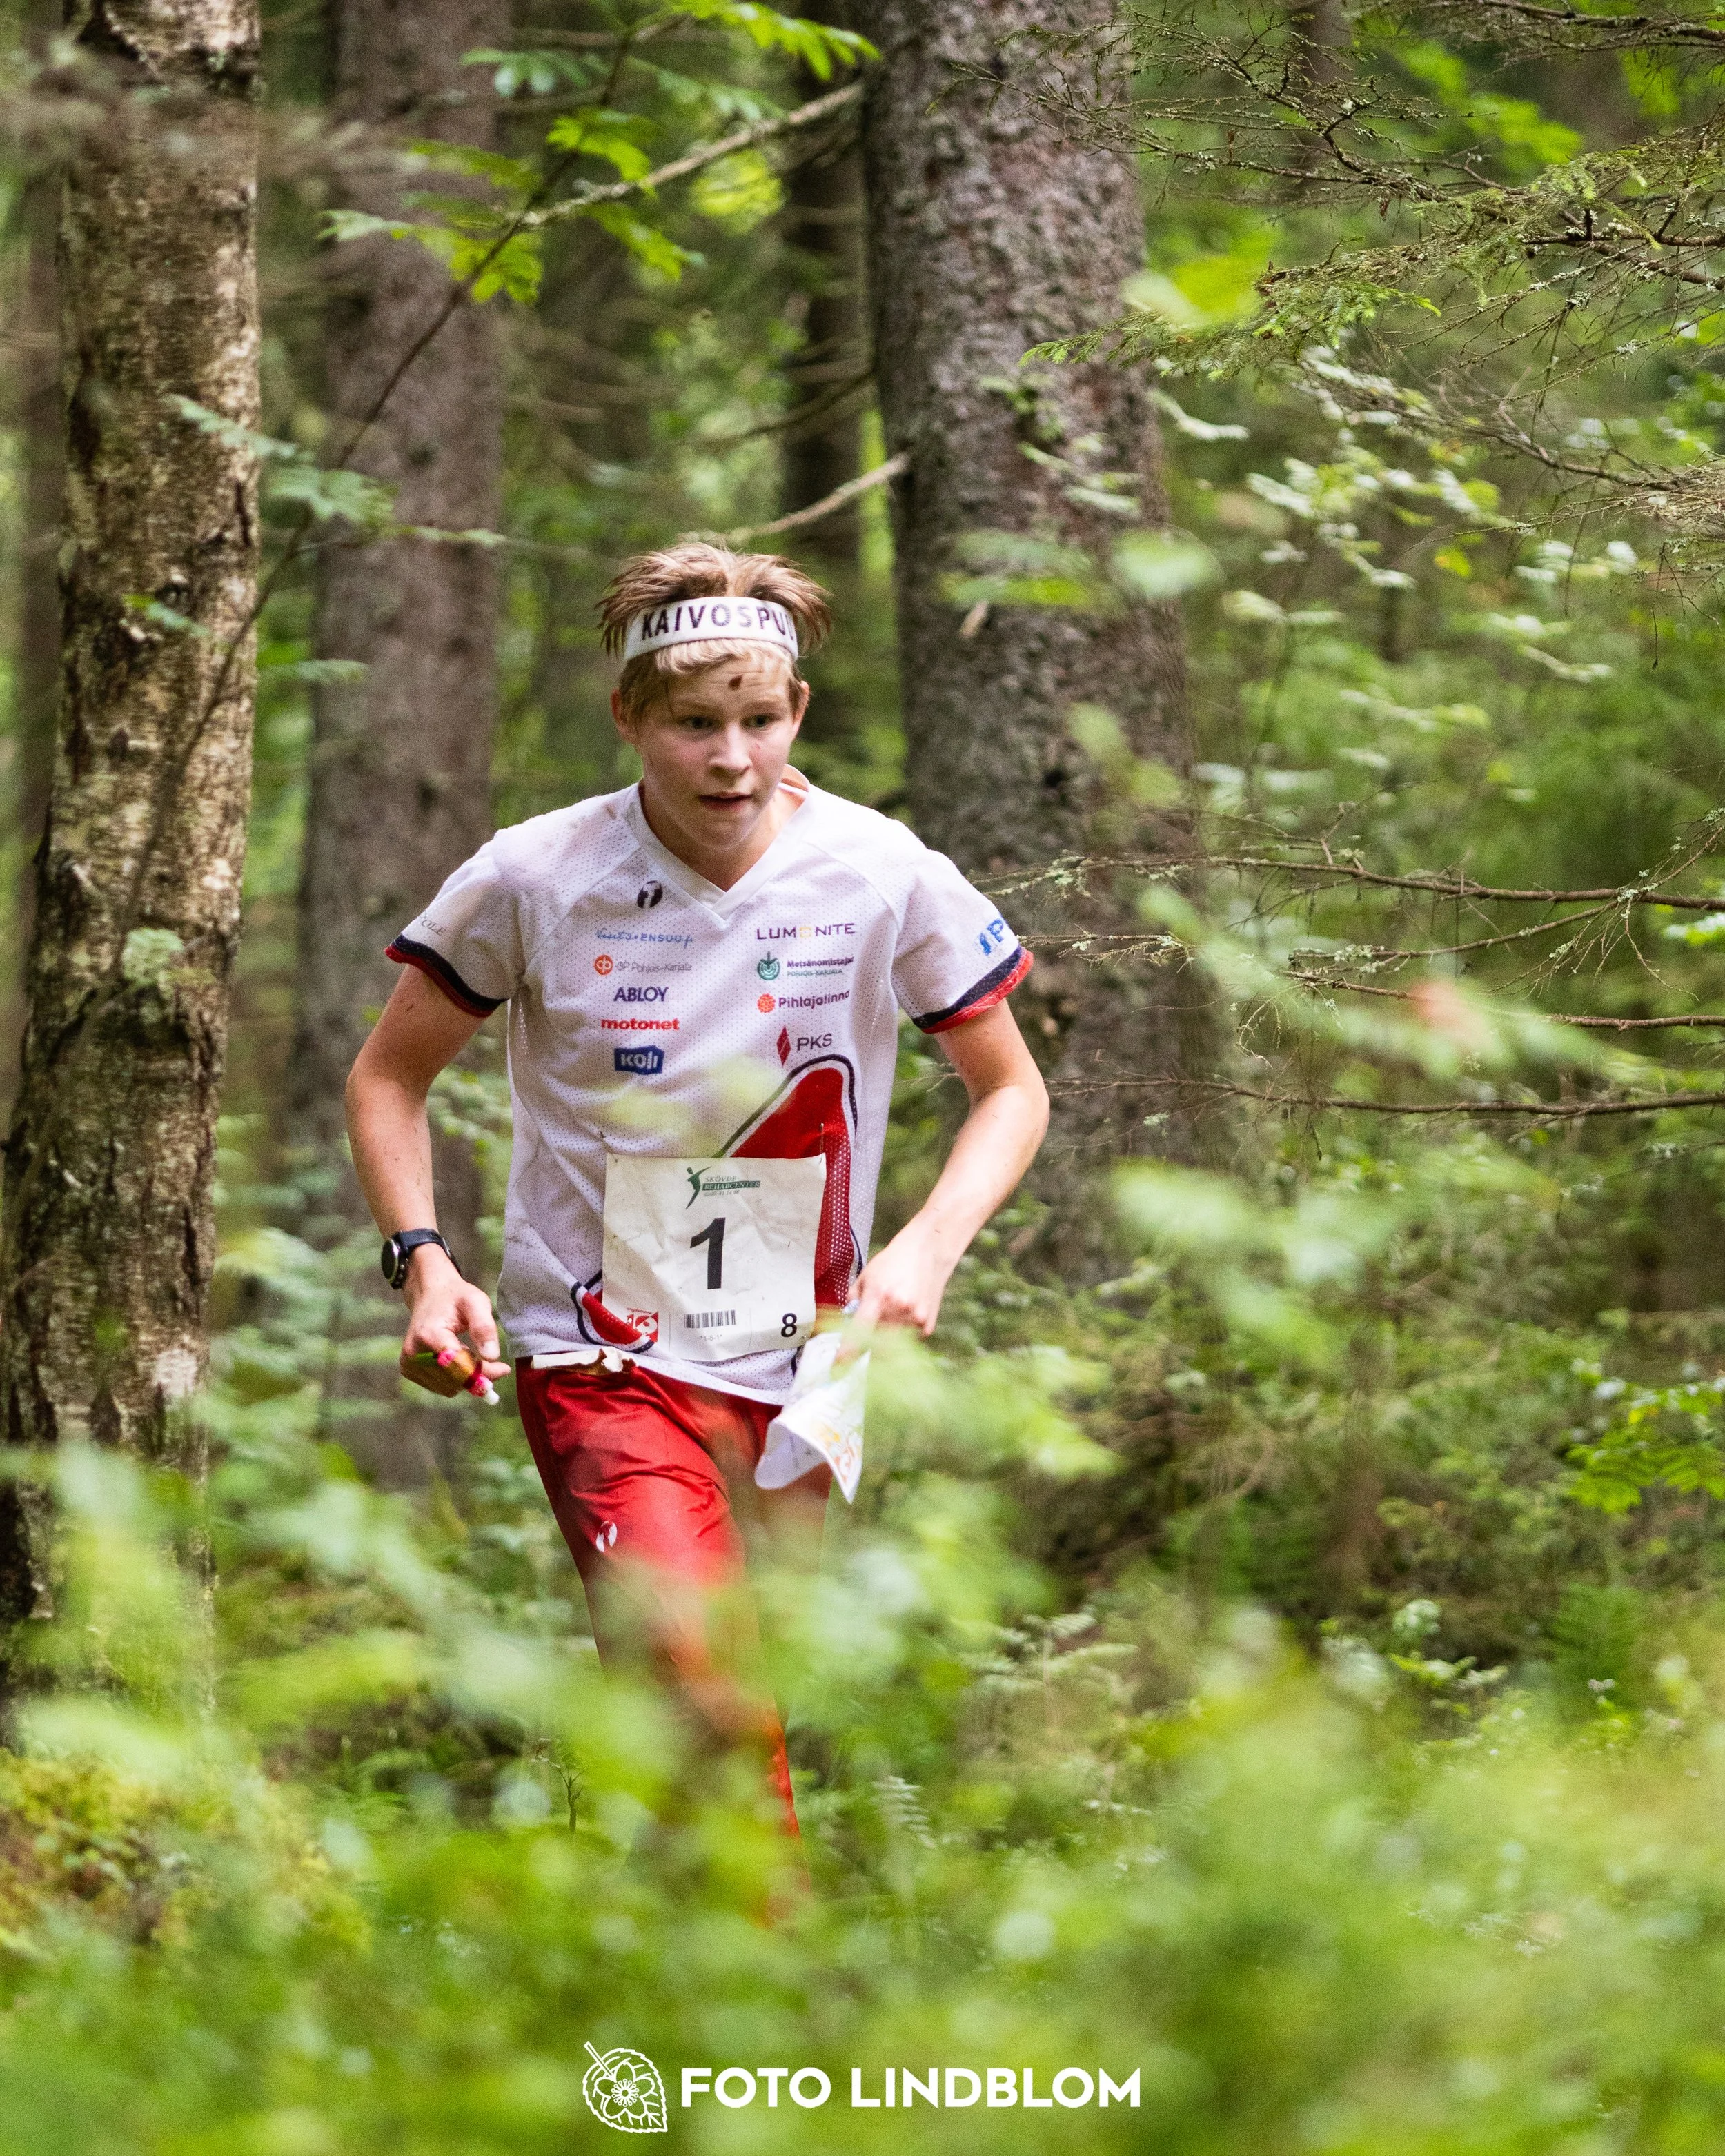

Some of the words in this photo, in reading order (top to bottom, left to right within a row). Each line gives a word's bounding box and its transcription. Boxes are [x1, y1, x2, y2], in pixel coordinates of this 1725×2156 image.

[757, 923, 856, 940] LUMONITE
[613, 987, 669, 1002] ABLOY
[600, 1018, 680, 1031] motonet
[796, 1033, 832, 1051] PKS
[690, 1217, 726, 1289] 1
[780, 1312, 798, 1338] 8
